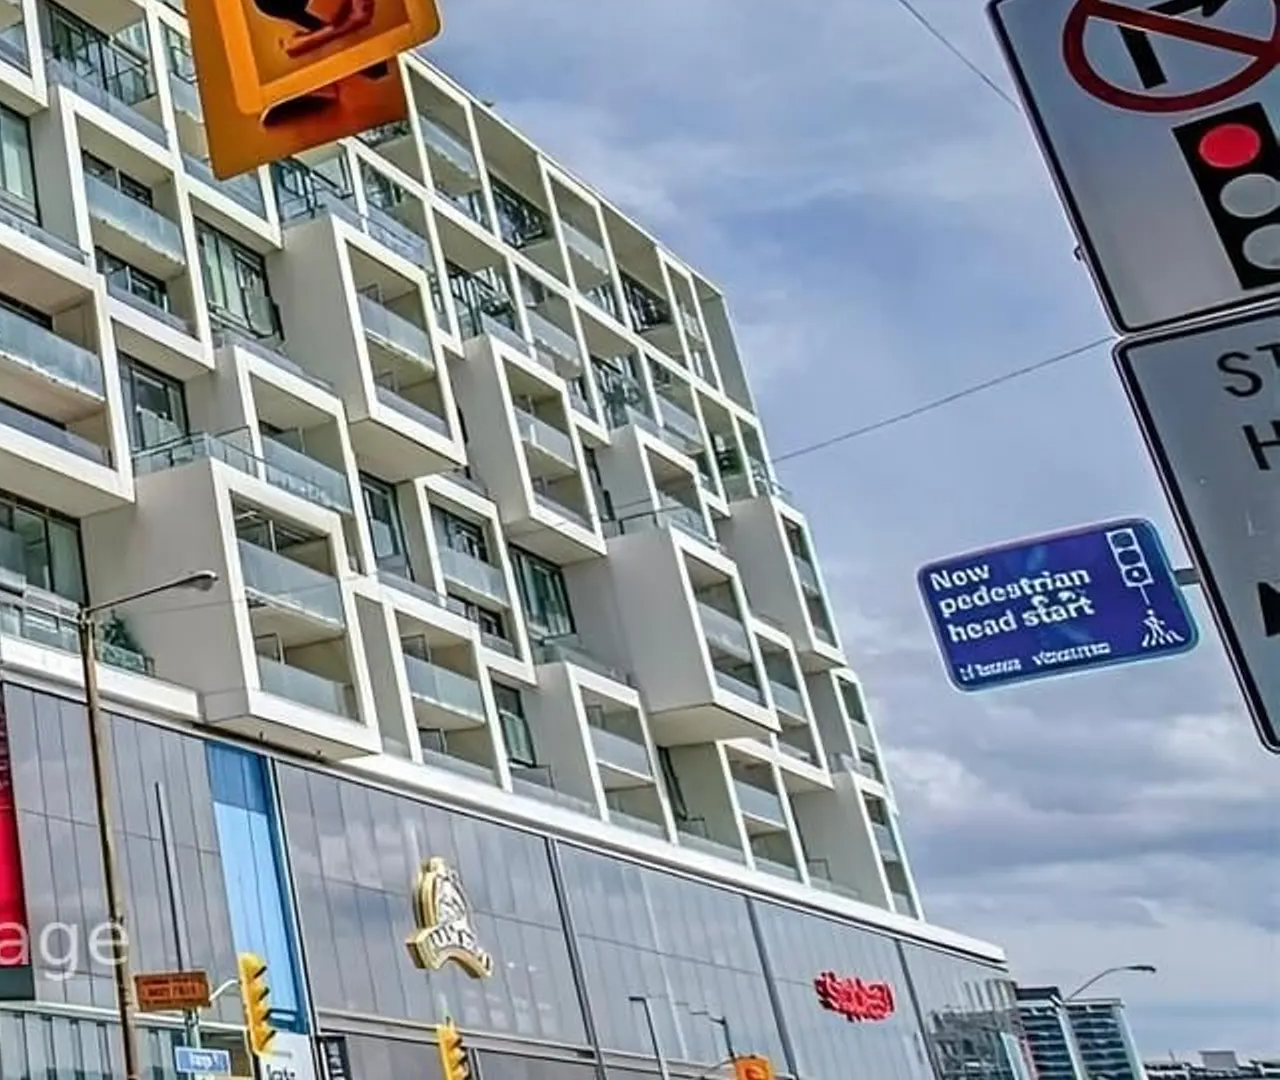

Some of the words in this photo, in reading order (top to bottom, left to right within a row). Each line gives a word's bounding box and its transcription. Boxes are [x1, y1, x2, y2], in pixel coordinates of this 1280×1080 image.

[930, 565, 990, 591] Now
[939, 569, 1091, 618] pedestrian
[947, 609, 1017, 642] head
[1022, 596, 1095, 627] start
